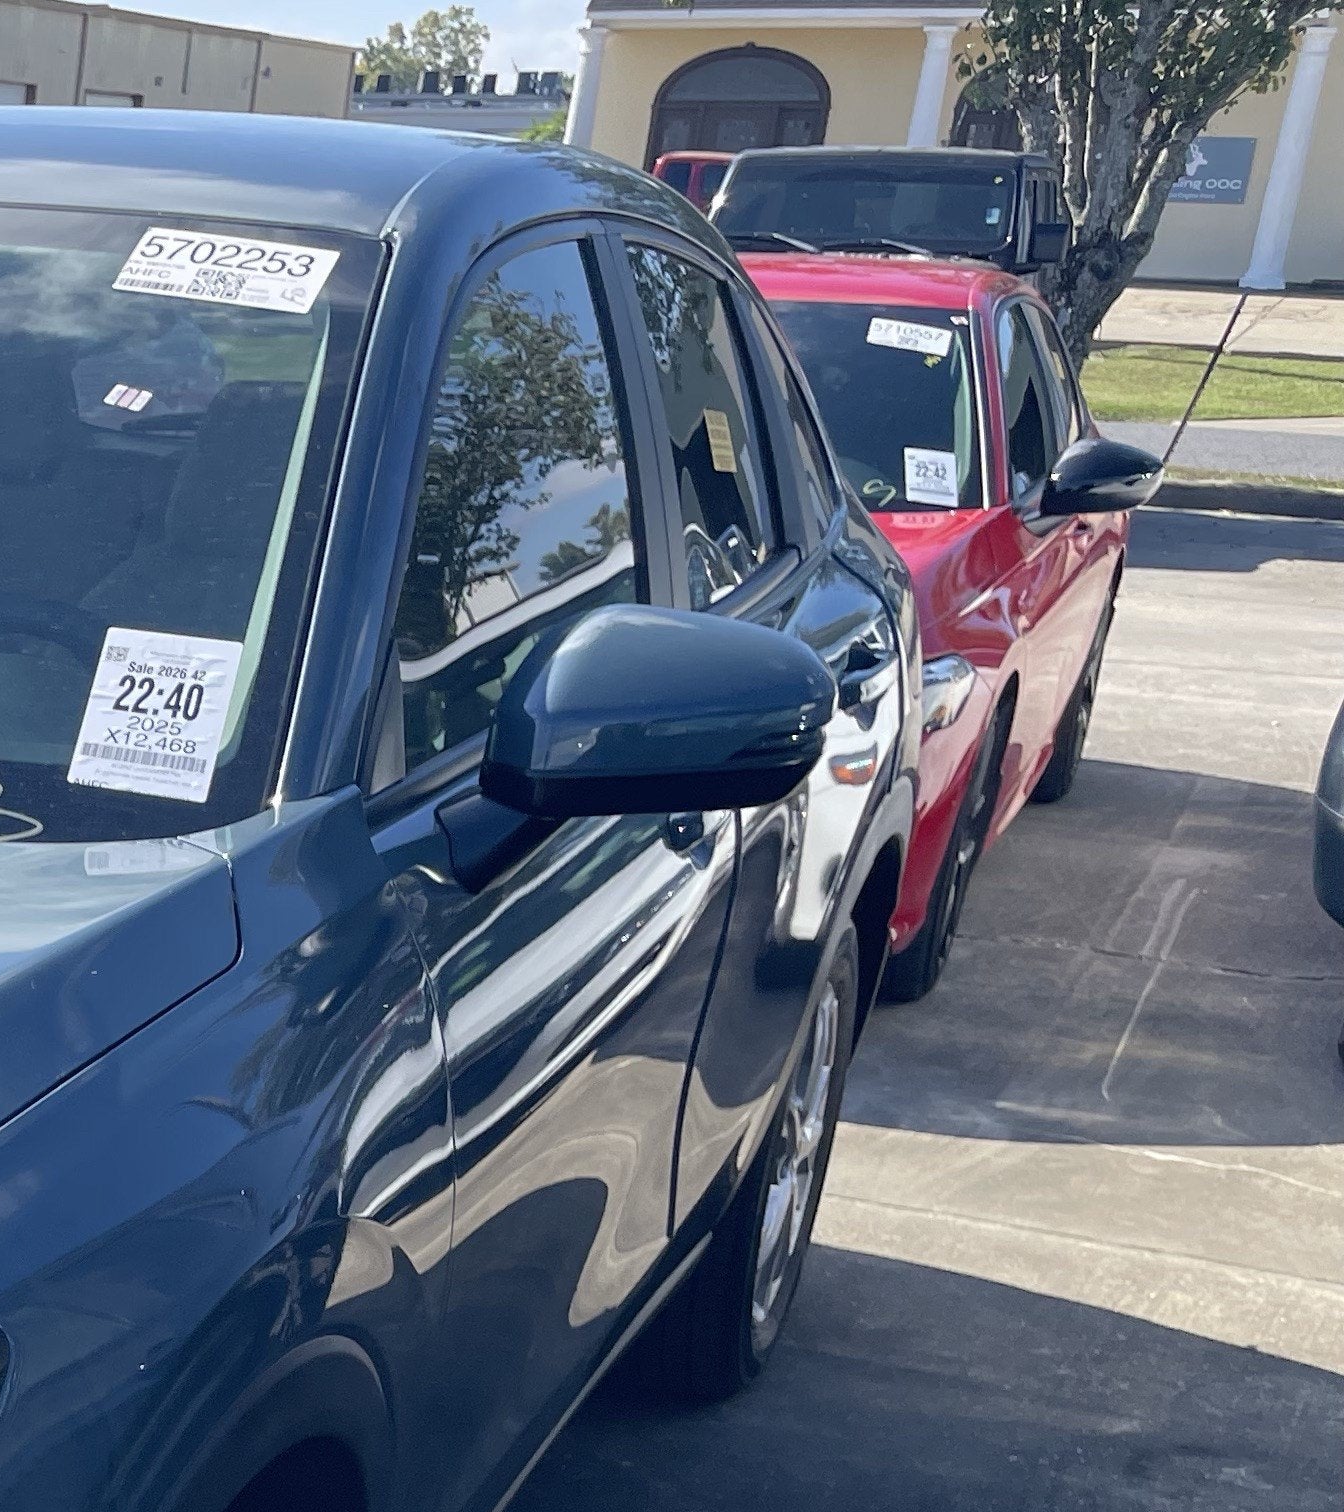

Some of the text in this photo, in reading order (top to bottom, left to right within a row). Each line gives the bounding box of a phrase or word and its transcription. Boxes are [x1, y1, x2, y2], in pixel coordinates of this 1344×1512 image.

[139, 234, 316, 277] 5702253
[127, 660, 207, 682] Sale 2026 42
[112, 674, 205, 721] 22:40
[125, 715, 183, 736] 2025
[103, 727, 197, 754] X12,468
